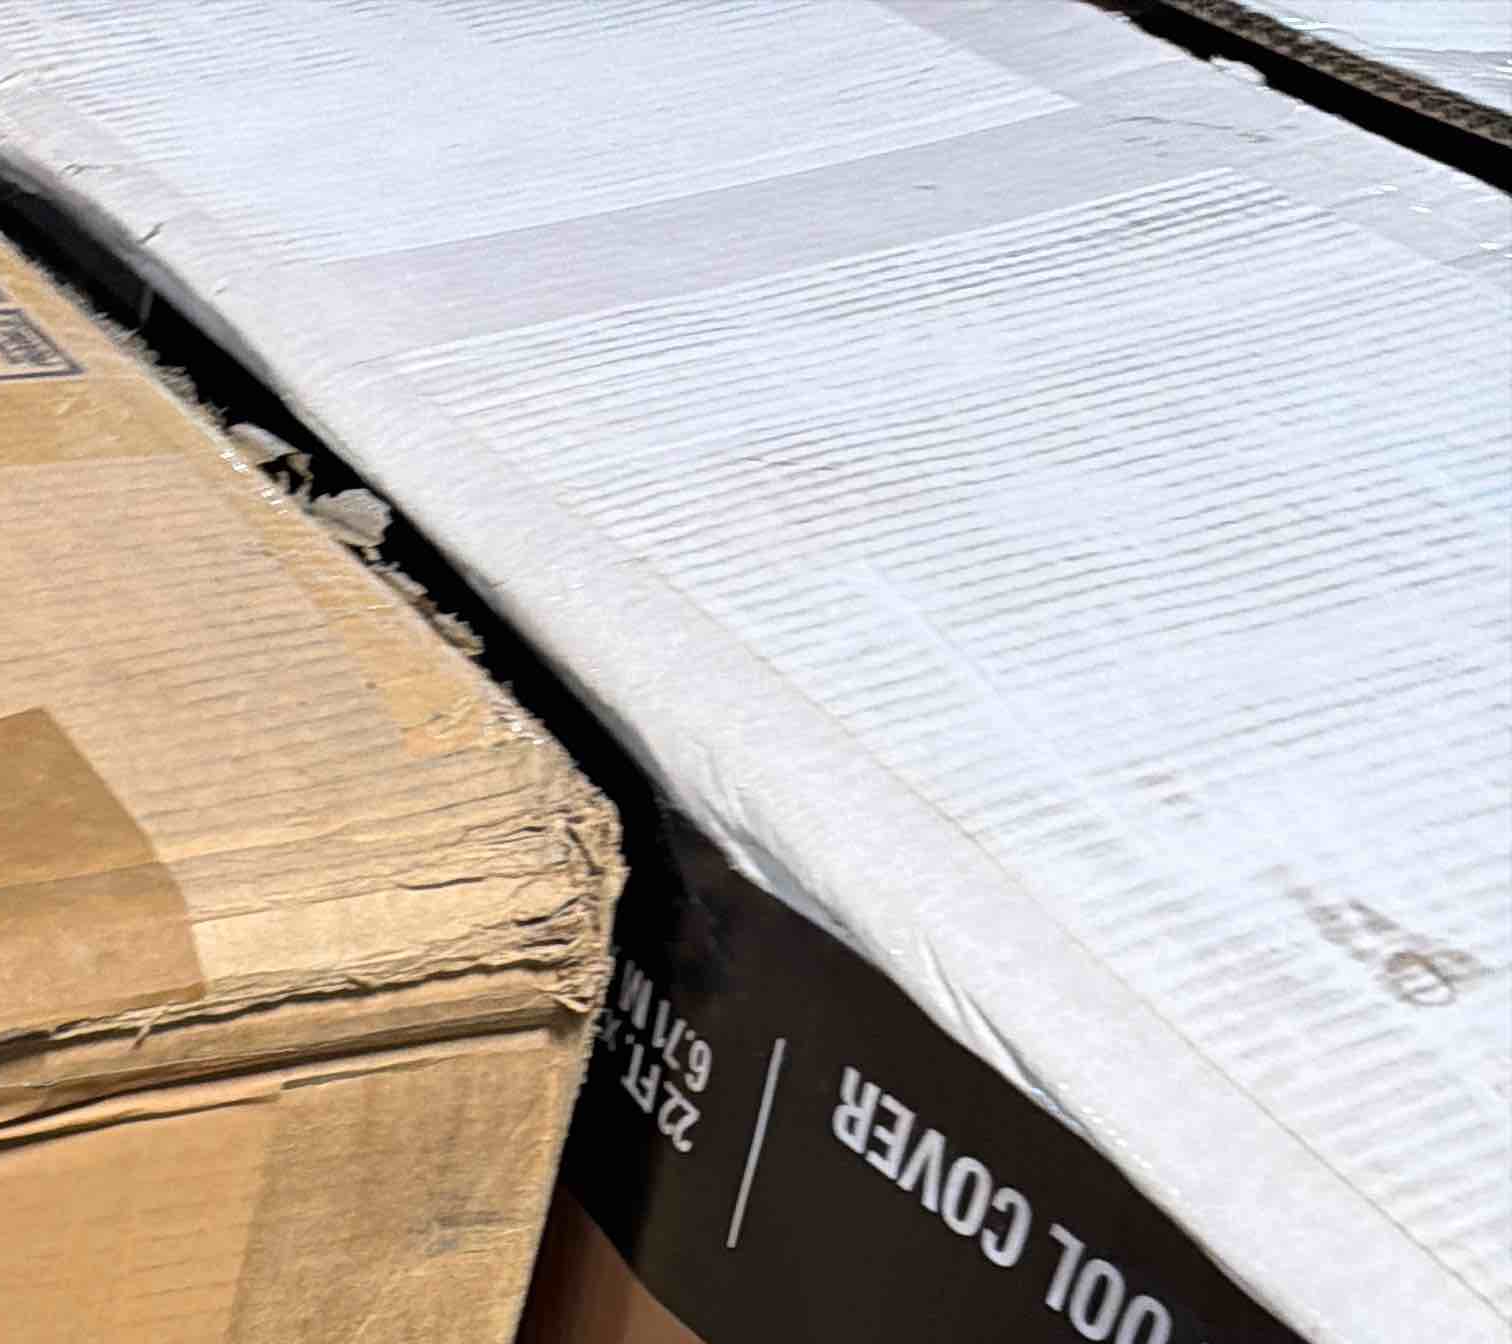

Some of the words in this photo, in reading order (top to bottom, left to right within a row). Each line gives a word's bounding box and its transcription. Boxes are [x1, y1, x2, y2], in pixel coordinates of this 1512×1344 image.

[620, 1033, 662, 1114] FT.
[652, 1000, 713, 1092] 6.71
[657, 1080, 701, 1152] 22
[831, 1066, 1033, 1269] COVER
